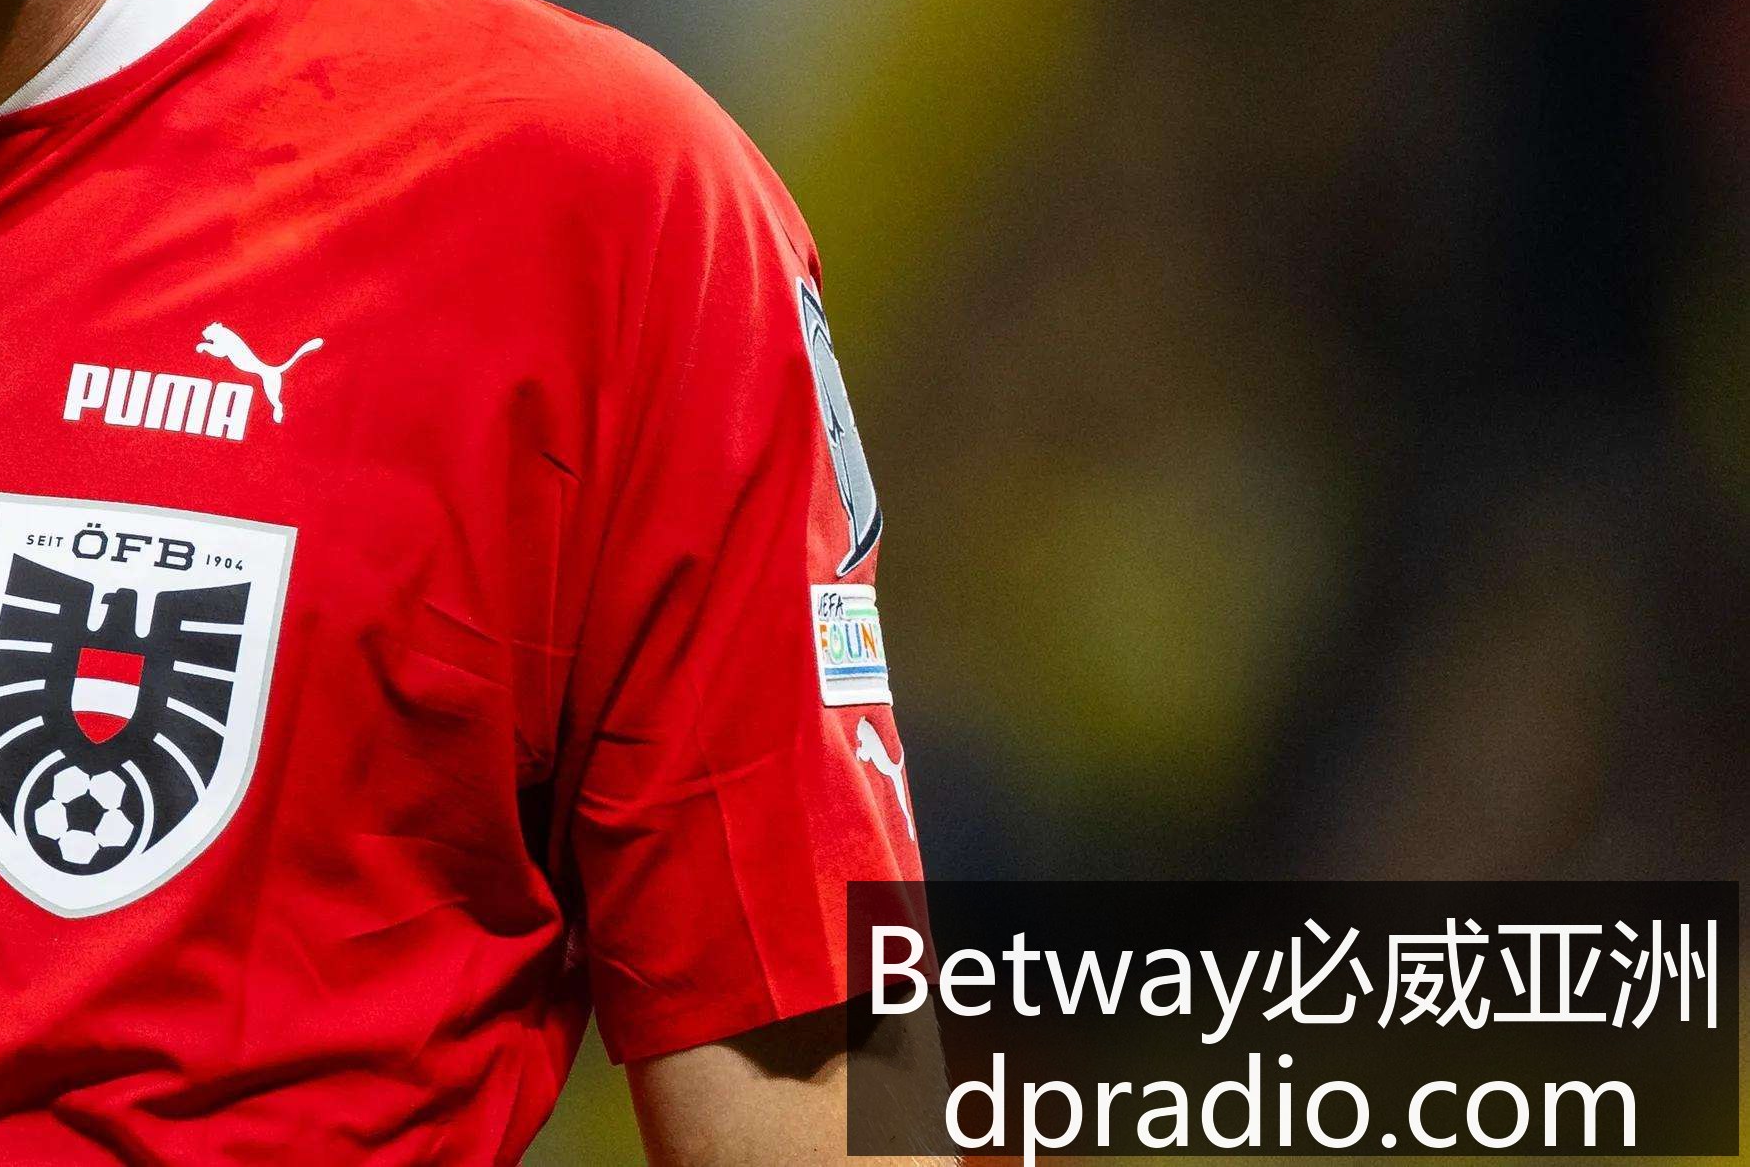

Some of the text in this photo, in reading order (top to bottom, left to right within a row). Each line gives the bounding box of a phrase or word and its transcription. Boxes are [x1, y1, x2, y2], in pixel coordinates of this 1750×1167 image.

[62, 363, 254, 441] PUMA
[26, 523, 245, 572] SEIT ÖFB 1904
